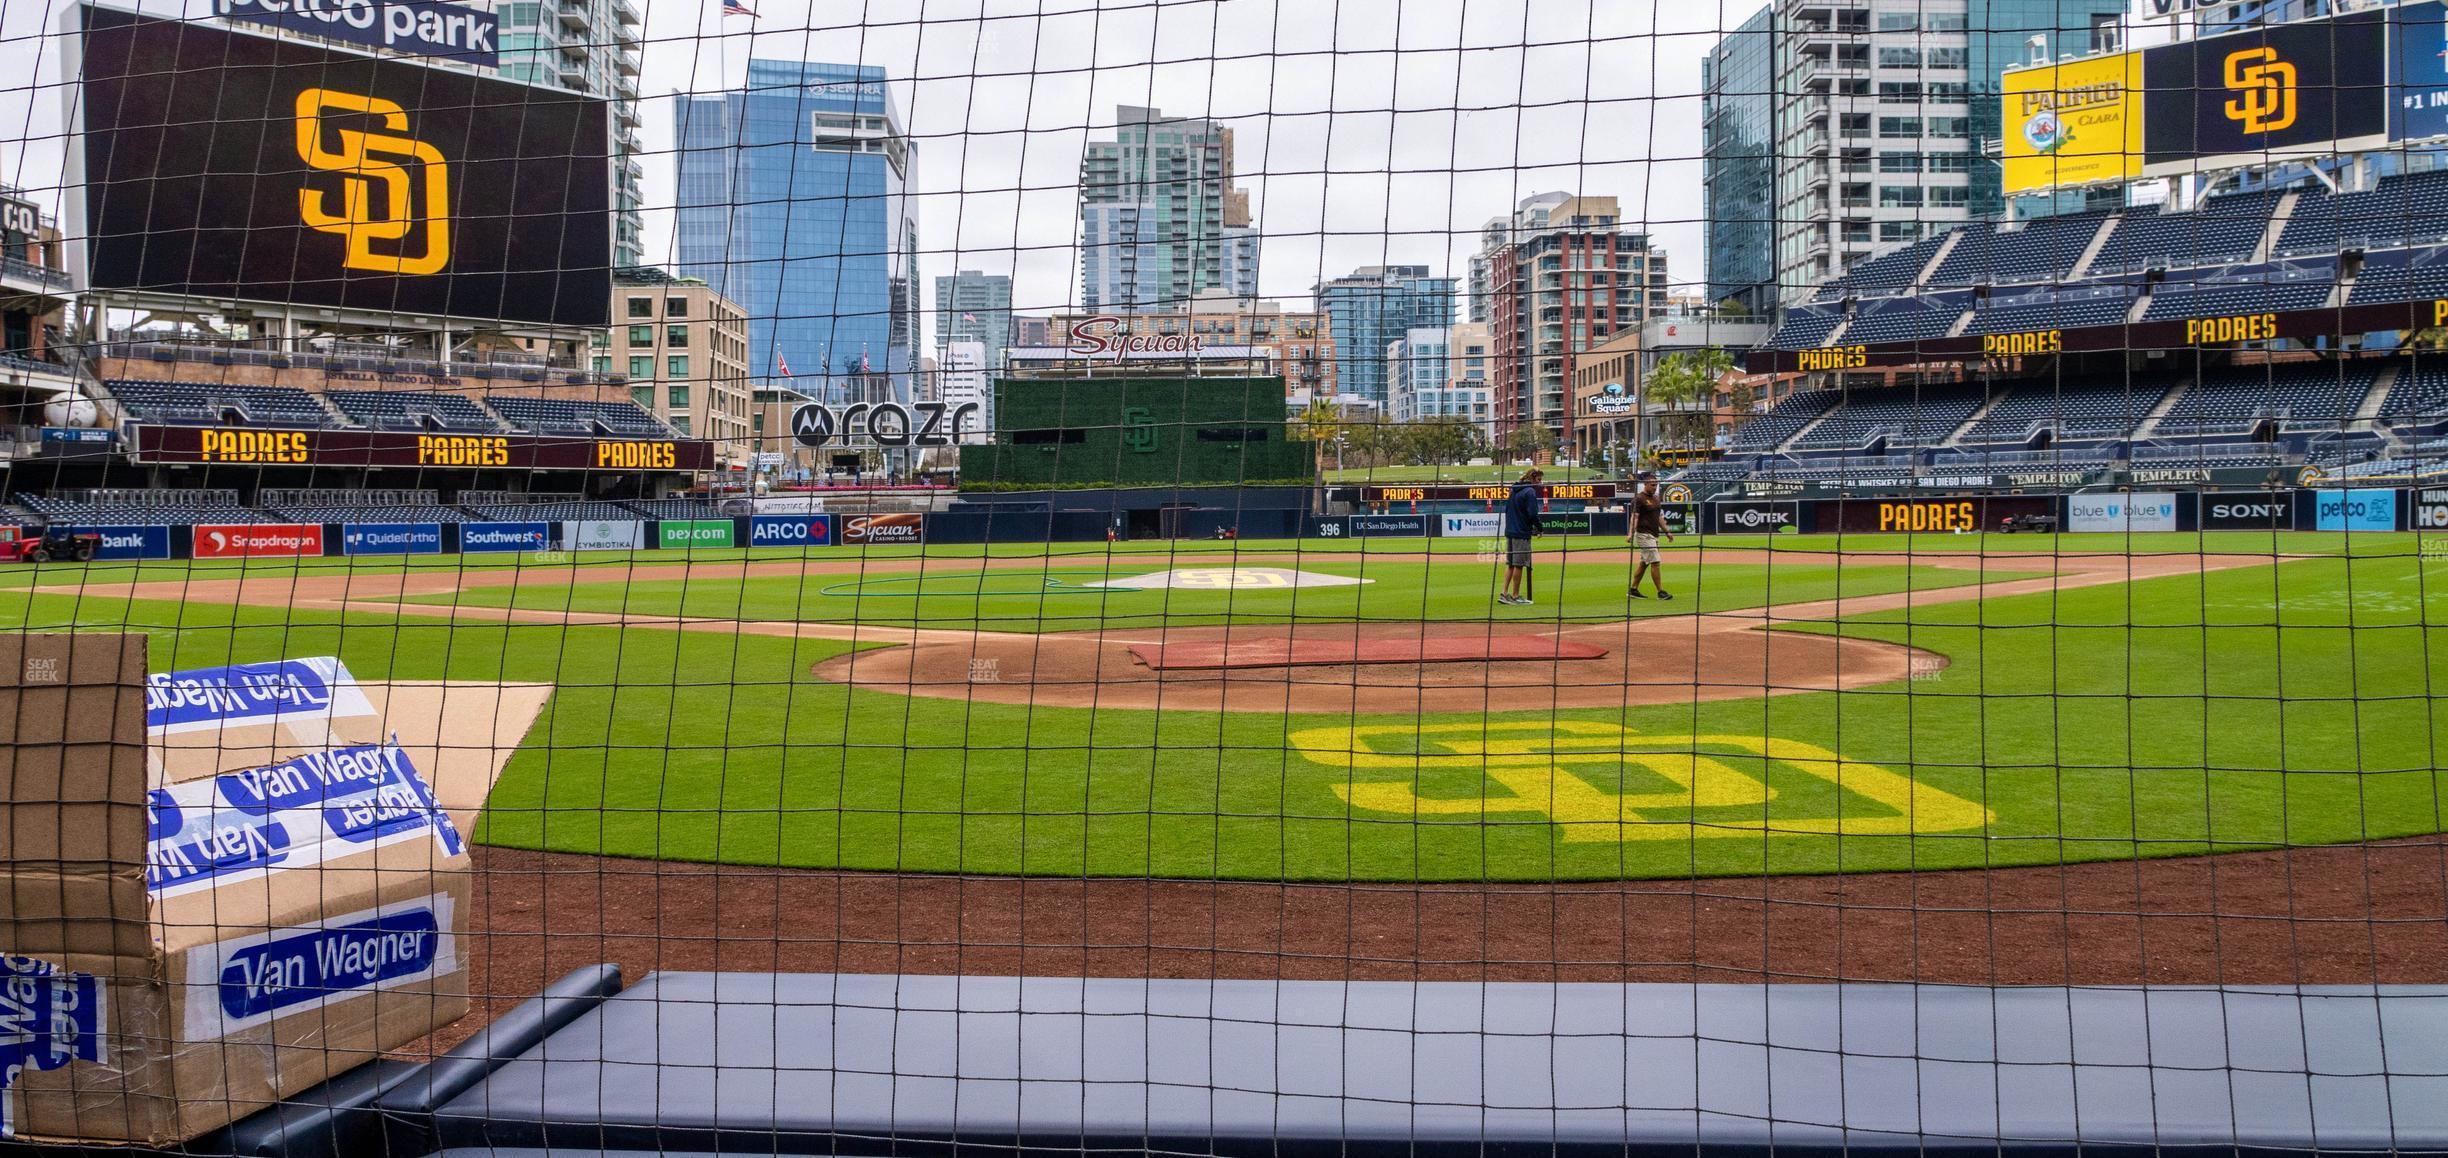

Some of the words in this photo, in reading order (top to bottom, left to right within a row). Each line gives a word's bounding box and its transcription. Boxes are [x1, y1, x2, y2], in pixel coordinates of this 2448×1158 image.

[383, 2, 495, 54] park
[828, 83, 882, 95] SEMPRA
[2403, 94, 2424, 109] #1
[296, 88, 449, 275] SD
[2187, 314, 2277, 344] PADRES
[1071, 317, 1206, 364] Sycuan
[1985, 330, 2062, 357] PADRES
[1798, 345, 1866, 371] PADRES
[1589, 396, 1637, 405] Gallagher
[1596, 405, 1630, 413] Square
[841, 402, 979, 446] razr
[201, 430, 307, 462] PADRES
[418, 436, 509, 465] PADRES
[598, 440, 676, 468] PADRES
[1918, 478, 1935, 486] SAN
[1936, 477, 1959, 486] DIEGO
[2008, 472, 2083, 485] TEMPLETON
[2131, 470, 2211, 482] TEMPLETON
[1553, 486, 1593, 498] PADRES
[2073, 505, 2104, 516] blue
[2124, 504, 2156, 516] blue
[2212, 504, 2286, 518] SONY
[2321, 496, 2366, 520] petco
[1464, 519, 1499, 527] Nationa
[1880, 502, 1973, 531] PADRES
[753, 523, 807, 539] ARCO
[846, 518, 915, 541] Sycuan
[1320, 523, 1340, 536] 396
[1380, 522, 1398, 531] Diego
[1398, 522, 1419, 530] Health
[1551, 521, 1572, 529] Diego
[231, 534, 315, 549] Snapdragon
[366, 532, 437, 545] QuidelOrtho
[465, 531, 534, 544] Southwest
[242, 671, 329, 706] Van
[235, 763, 311, 802] Van
[192, 822, 290, 862] Van
[226, 952, 306, 999] Van
[314, 928, 428, 981] Wagner
